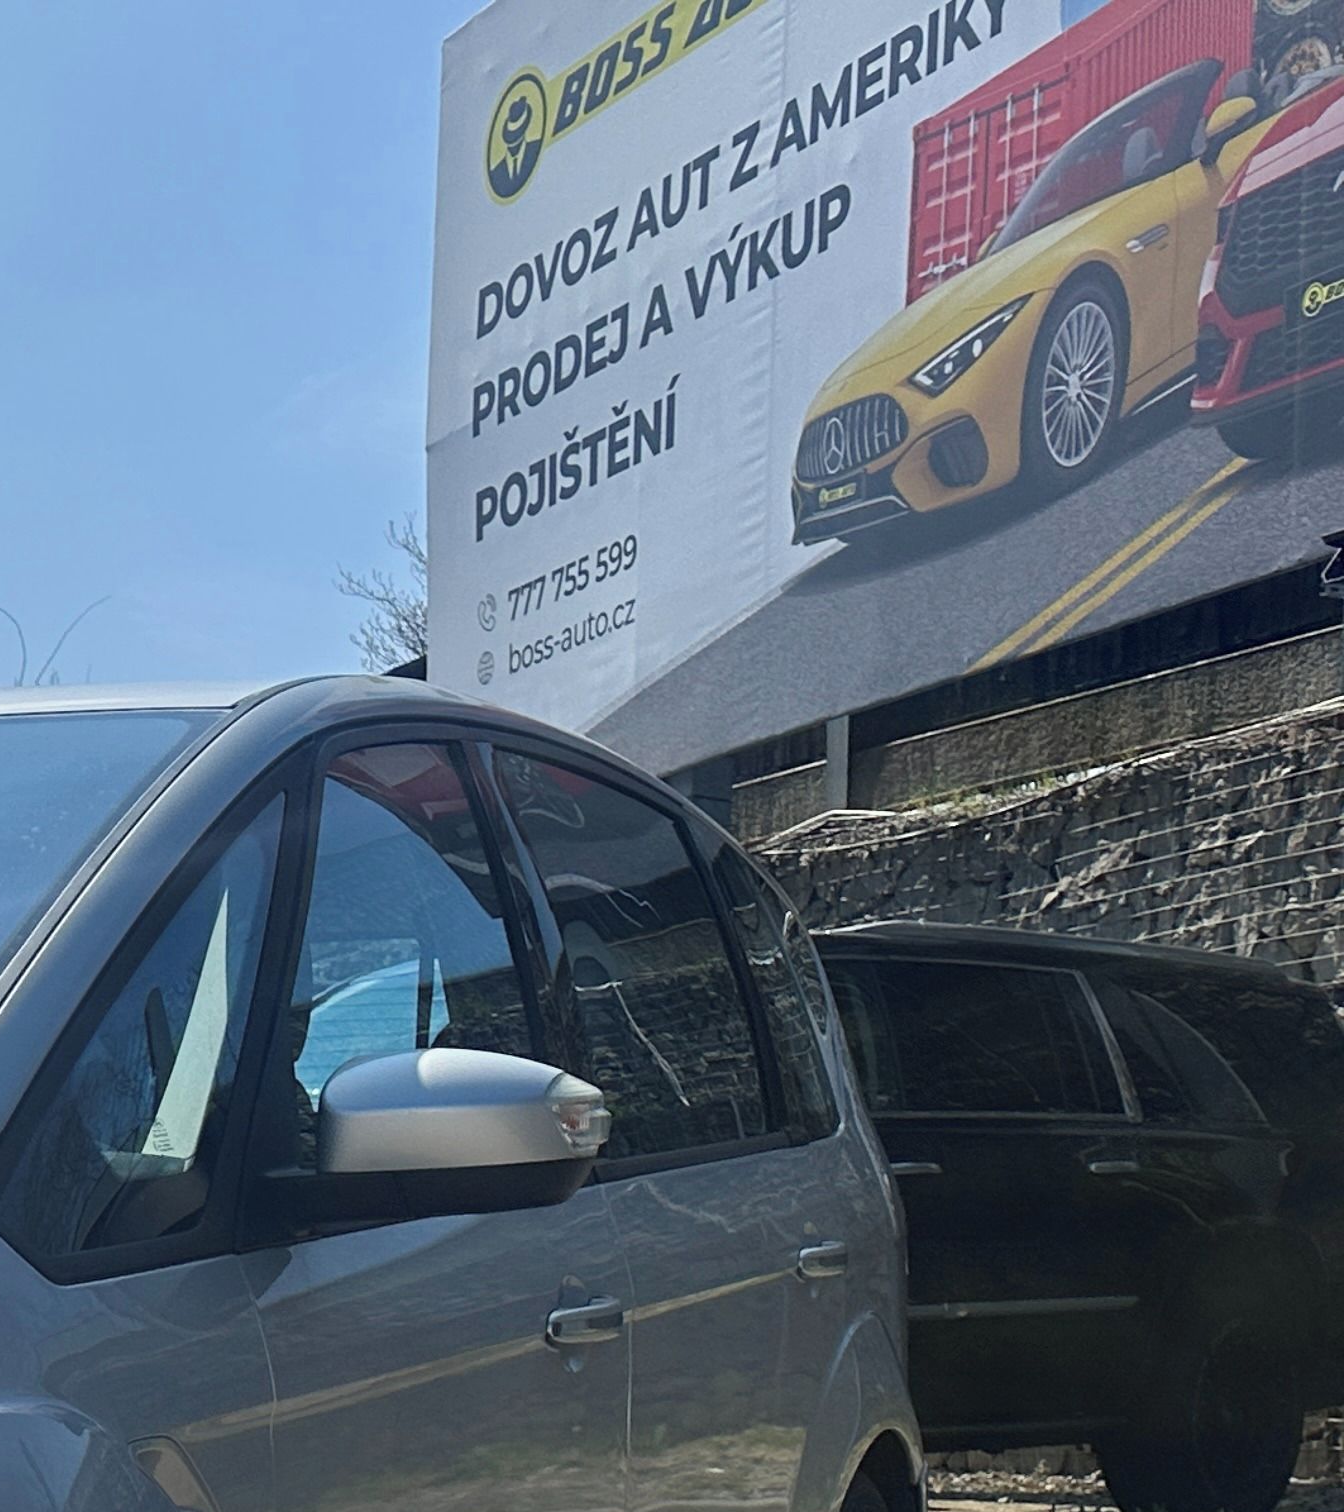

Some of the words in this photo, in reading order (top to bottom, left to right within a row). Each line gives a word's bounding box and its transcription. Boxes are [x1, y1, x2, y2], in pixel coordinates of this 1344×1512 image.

[552, 1, 677, 137] BOSS
[477, 206, 619, 340] DOVOZ
[627, 145, 720, 252] AUT
[729, 120, 760, 192] Z
[770, 0, 1009, 168] AMERIKY
[472, 302, 629, 438] PRODEJ
[639, 284, 673, 349] A
[684, 184, 851, 319] VÝKUP
[476, 373, 681, 542] POJIŠTĚNÍ
[508, 574, 546, 621] 777
[551, 555, 589, 601] 755
[595, 535, 637, 582] 599
[509, 599, 636, 675] boss-auto.cz
